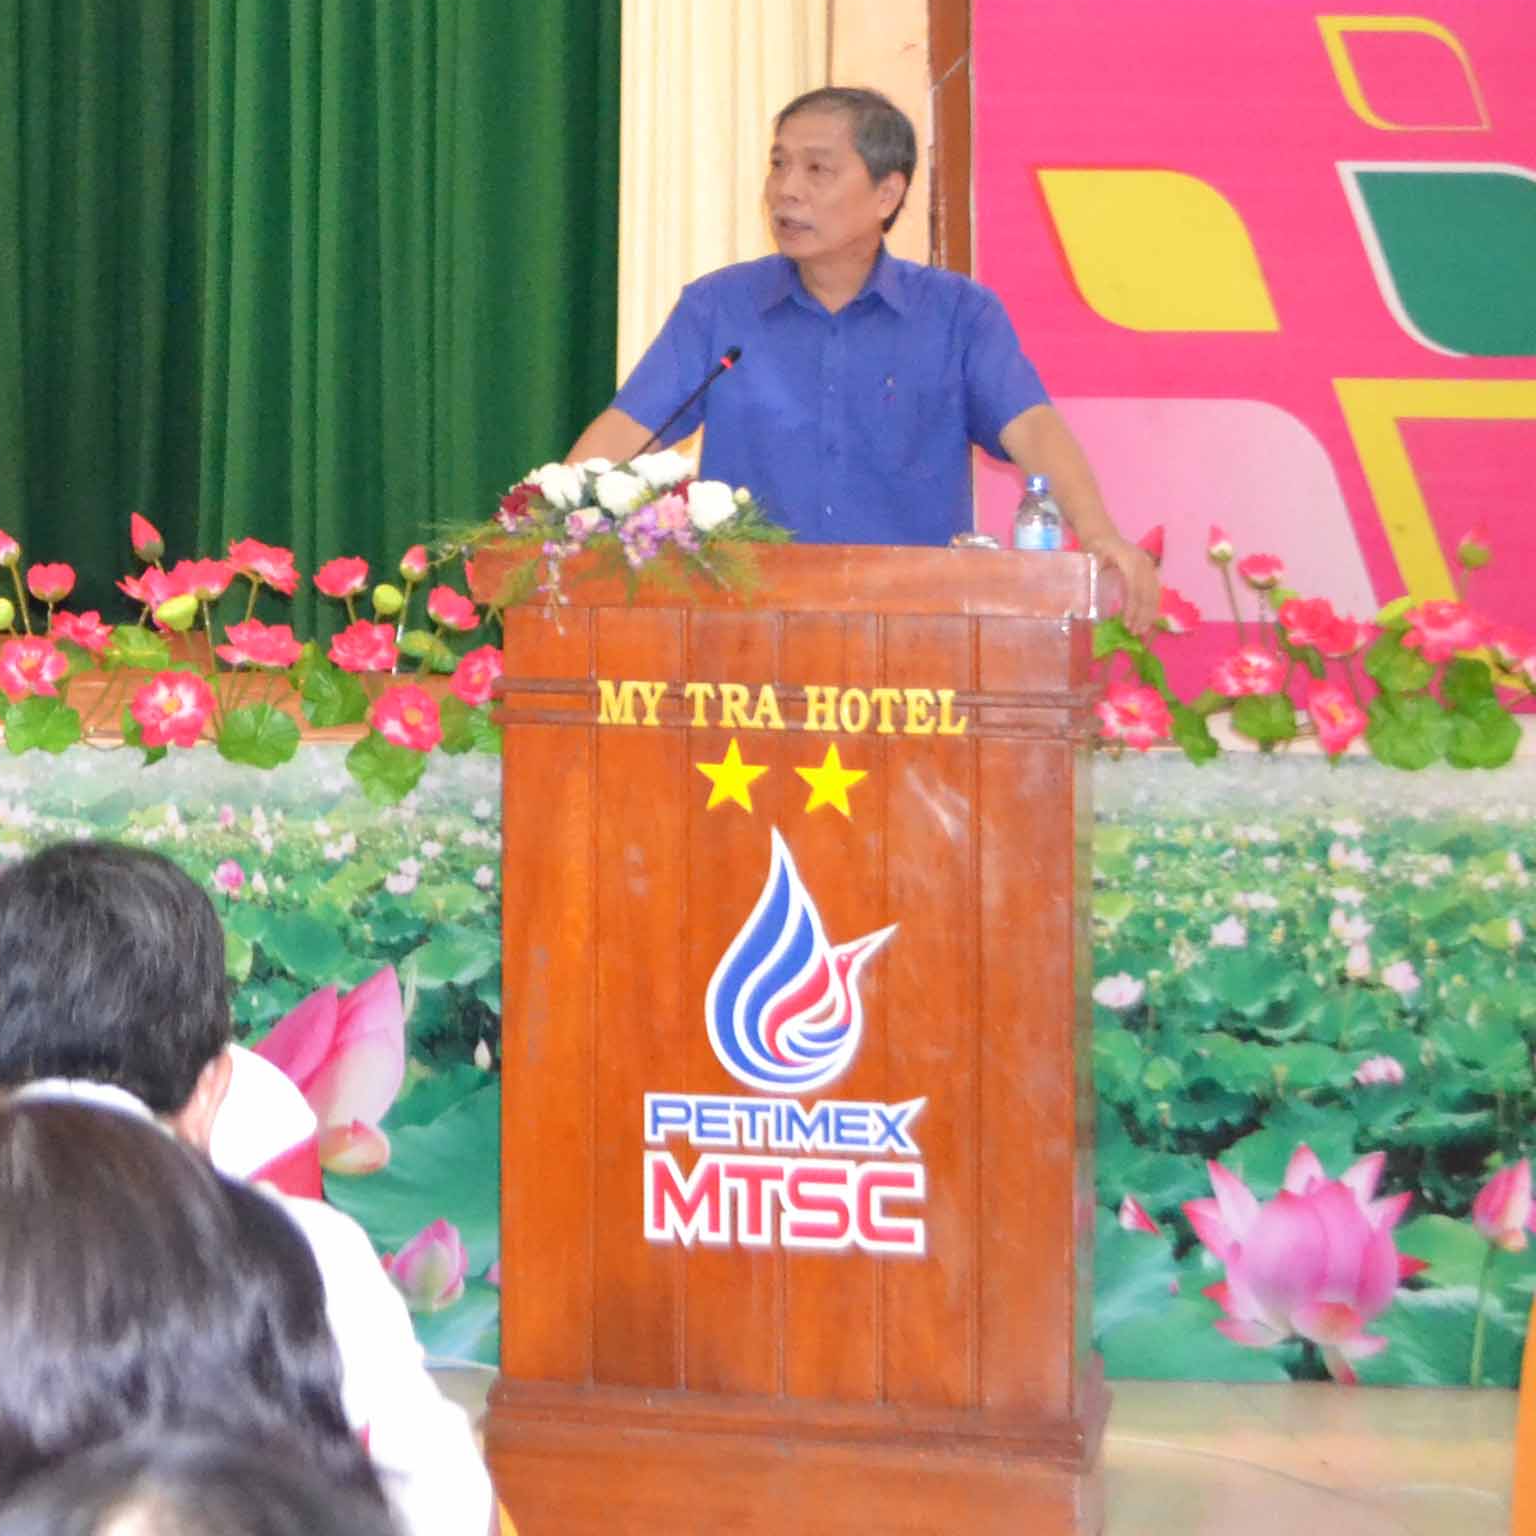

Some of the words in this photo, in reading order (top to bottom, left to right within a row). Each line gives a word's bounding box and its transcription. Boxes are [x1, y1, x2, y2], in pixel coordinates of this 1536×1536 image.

[597, 679, 669, 727] MY
[683, 682, 785, 730] TRA
[803, 685, 967, 736] HOTEL
[645, 1094, 926, 1153] PETIMEX
[645, 1152, 925, 1252] MTSC
